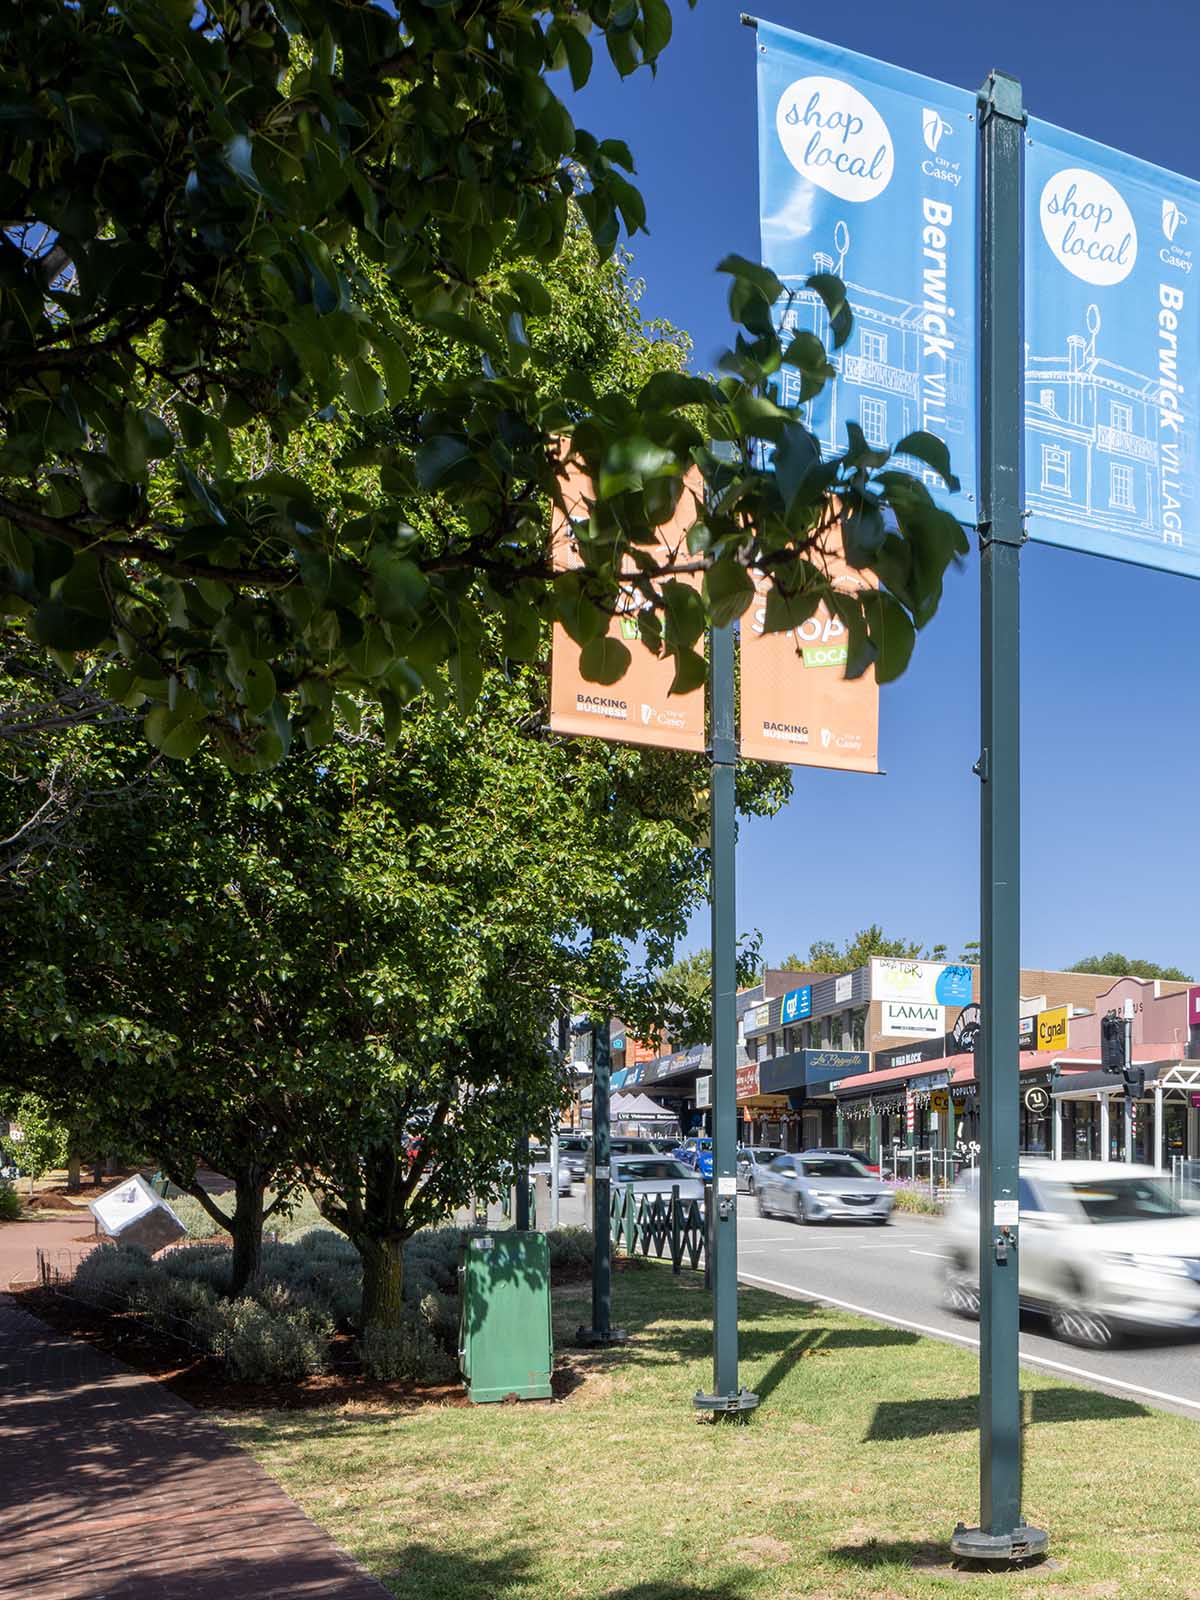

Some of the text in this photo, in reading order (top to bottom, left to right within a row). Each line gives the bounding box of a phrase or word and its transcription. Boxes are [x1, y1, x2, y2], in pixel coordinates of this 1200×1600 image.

[785, 92, 864, 144] shop
[804, 130, 887, 180] local
[921, 160, 962, 186] Casey
[1047, 184, 1113, 232] shop
[1062, 221, 1131, 265] local
[1159, 248, 1193, 274] Casey
[922, 198, 956, 488] Berwick VILLE
[1158, 283, 1185, 547] Berwick VILLAGE
[752, 607, 845, 642] SOP
[806, 649, 847, 664] LOCA
[576, 694, 628, 710] BACKING
[576, 703, 628, 717] BUSINESS
[763, 721, 809, 734] BACKING
[888, 1004, 938, 1020] LAMAI
